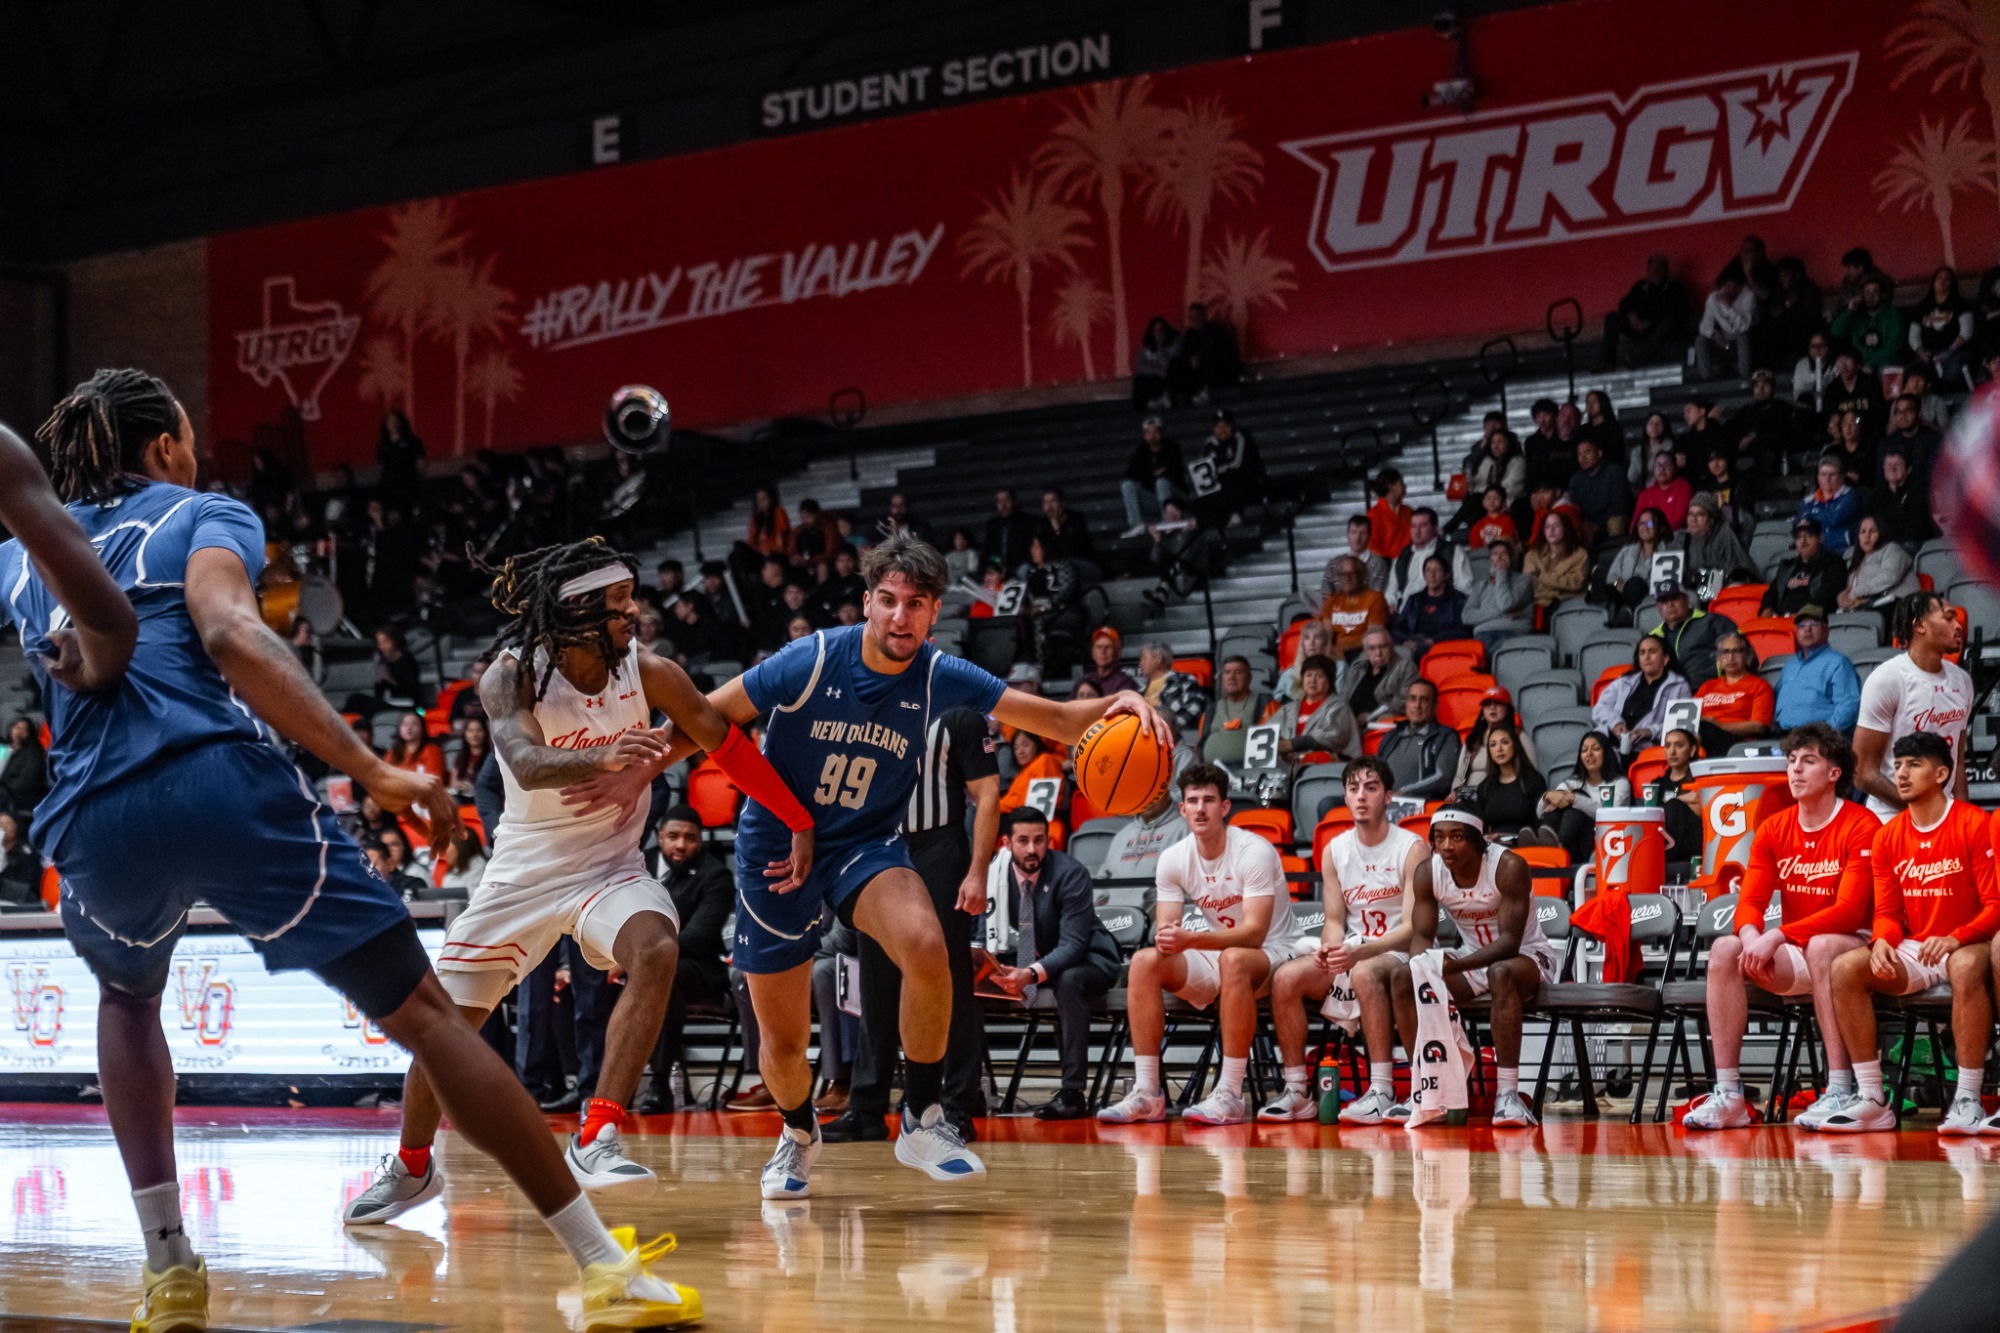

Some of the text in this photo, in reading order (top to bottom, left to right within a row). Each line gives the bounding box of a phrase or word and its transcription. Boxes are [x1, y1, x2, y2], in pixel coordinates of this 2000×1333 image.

[1249, 0, 1282, 49] F
[763, 34, 1110, 126] STUDENT SECTION
[593, 116, 620, 163] E
[1318, 70, 1840, 258] UTRGV
[519, 223, 945, 347] #RALLY THE VALLEY
[1193, 462, 1215, 490] 3
[998, 585, 1021, 613] 3
[1913, 706, 1966, 732] Vaqueros
[810, 720, 909, 760] NEW ORLEANS
[1248, 727, 1276, 768] 3
[814, 753, 877, 811] 99
[1031, 780, 1056, 820] 3
[1710, 792, 1747, 837] G
[1604, 830, 1625, 857] G
[1776, 854, 1843, 883] Vaqueros
[1893, 857, 1964, 886] Vaqueros
[1343, 885, 1401, 905] Vaqueros
[1361, 909, 1388, 938] 13
[1451, 907, 1499, 923] Vaquero
[1320, 1076, 1333, 1091] G
